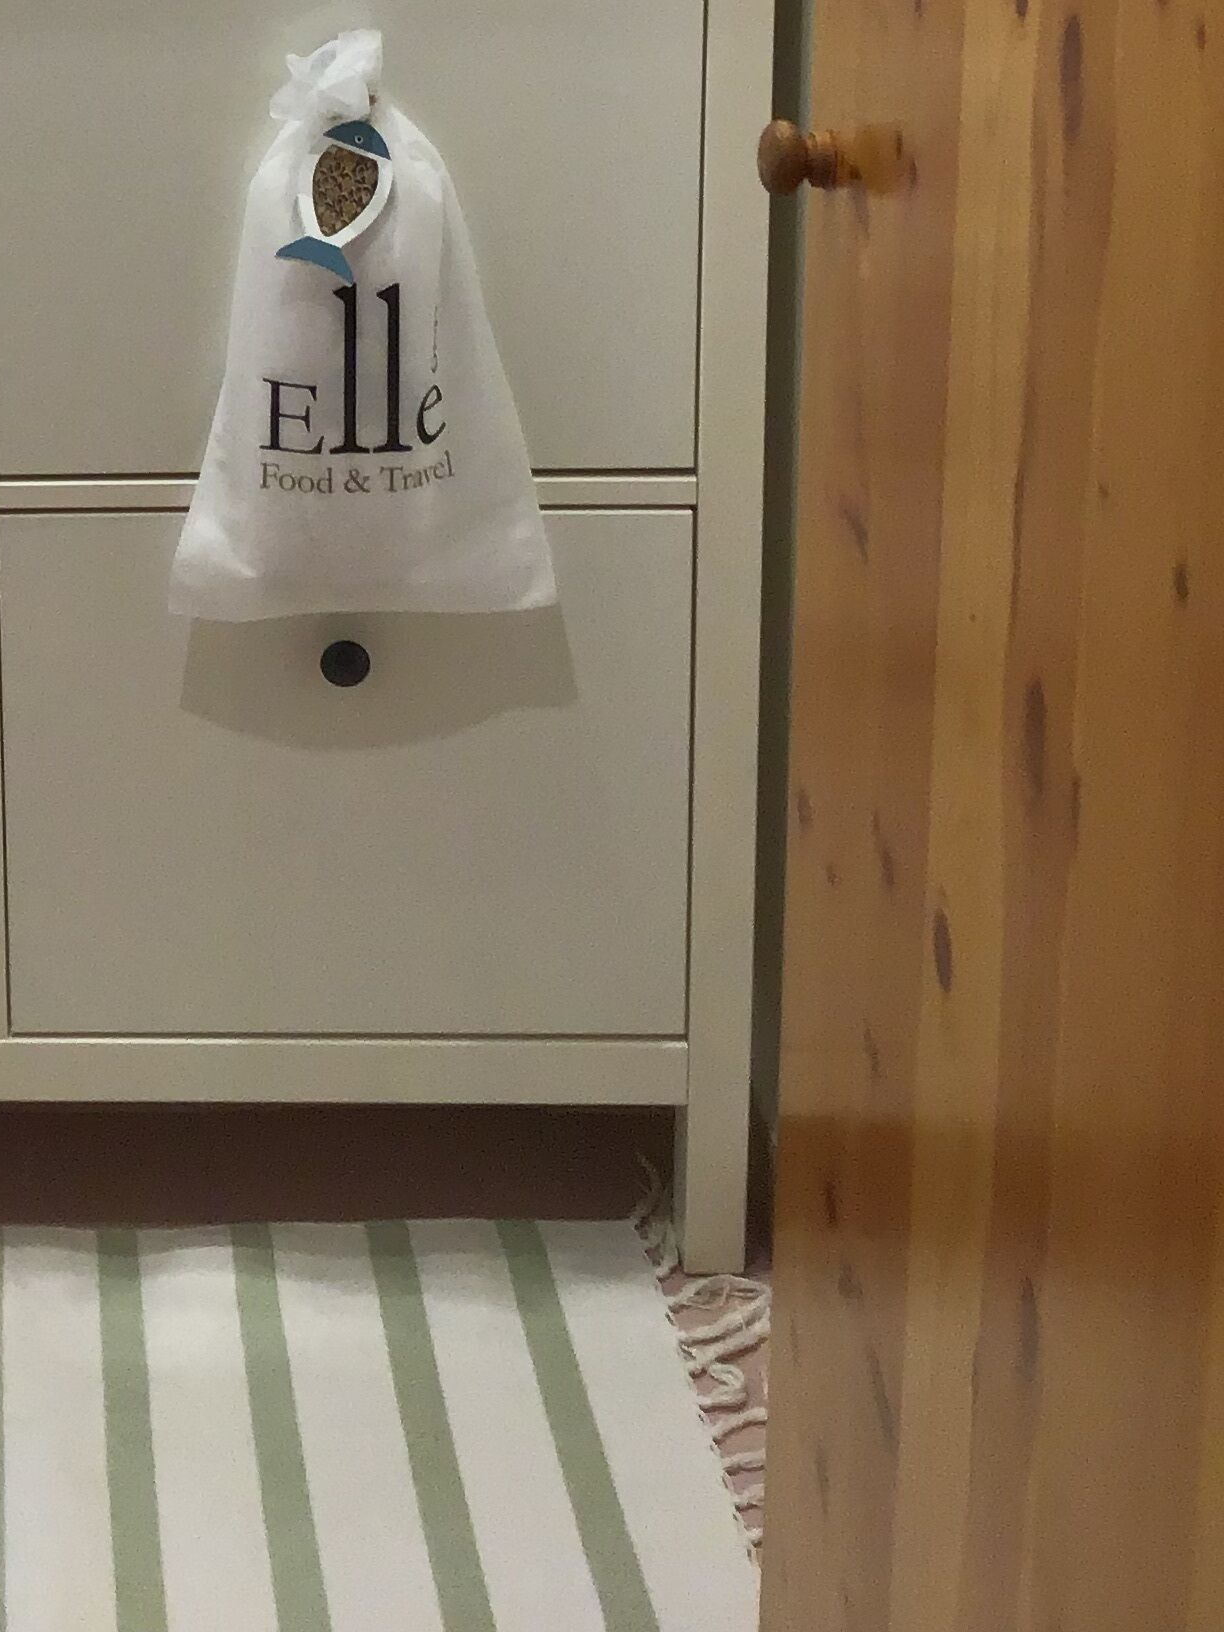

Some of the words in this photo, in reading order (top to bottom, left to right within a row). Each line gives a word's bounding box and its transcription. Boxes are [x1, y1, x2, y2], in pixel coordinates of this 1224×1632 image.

[259, 282, 447, 455] Elle
[260, 462, 333, 494] Food
[343, 468, 371, 494] &
[380, 449, 455, 493] Travel
